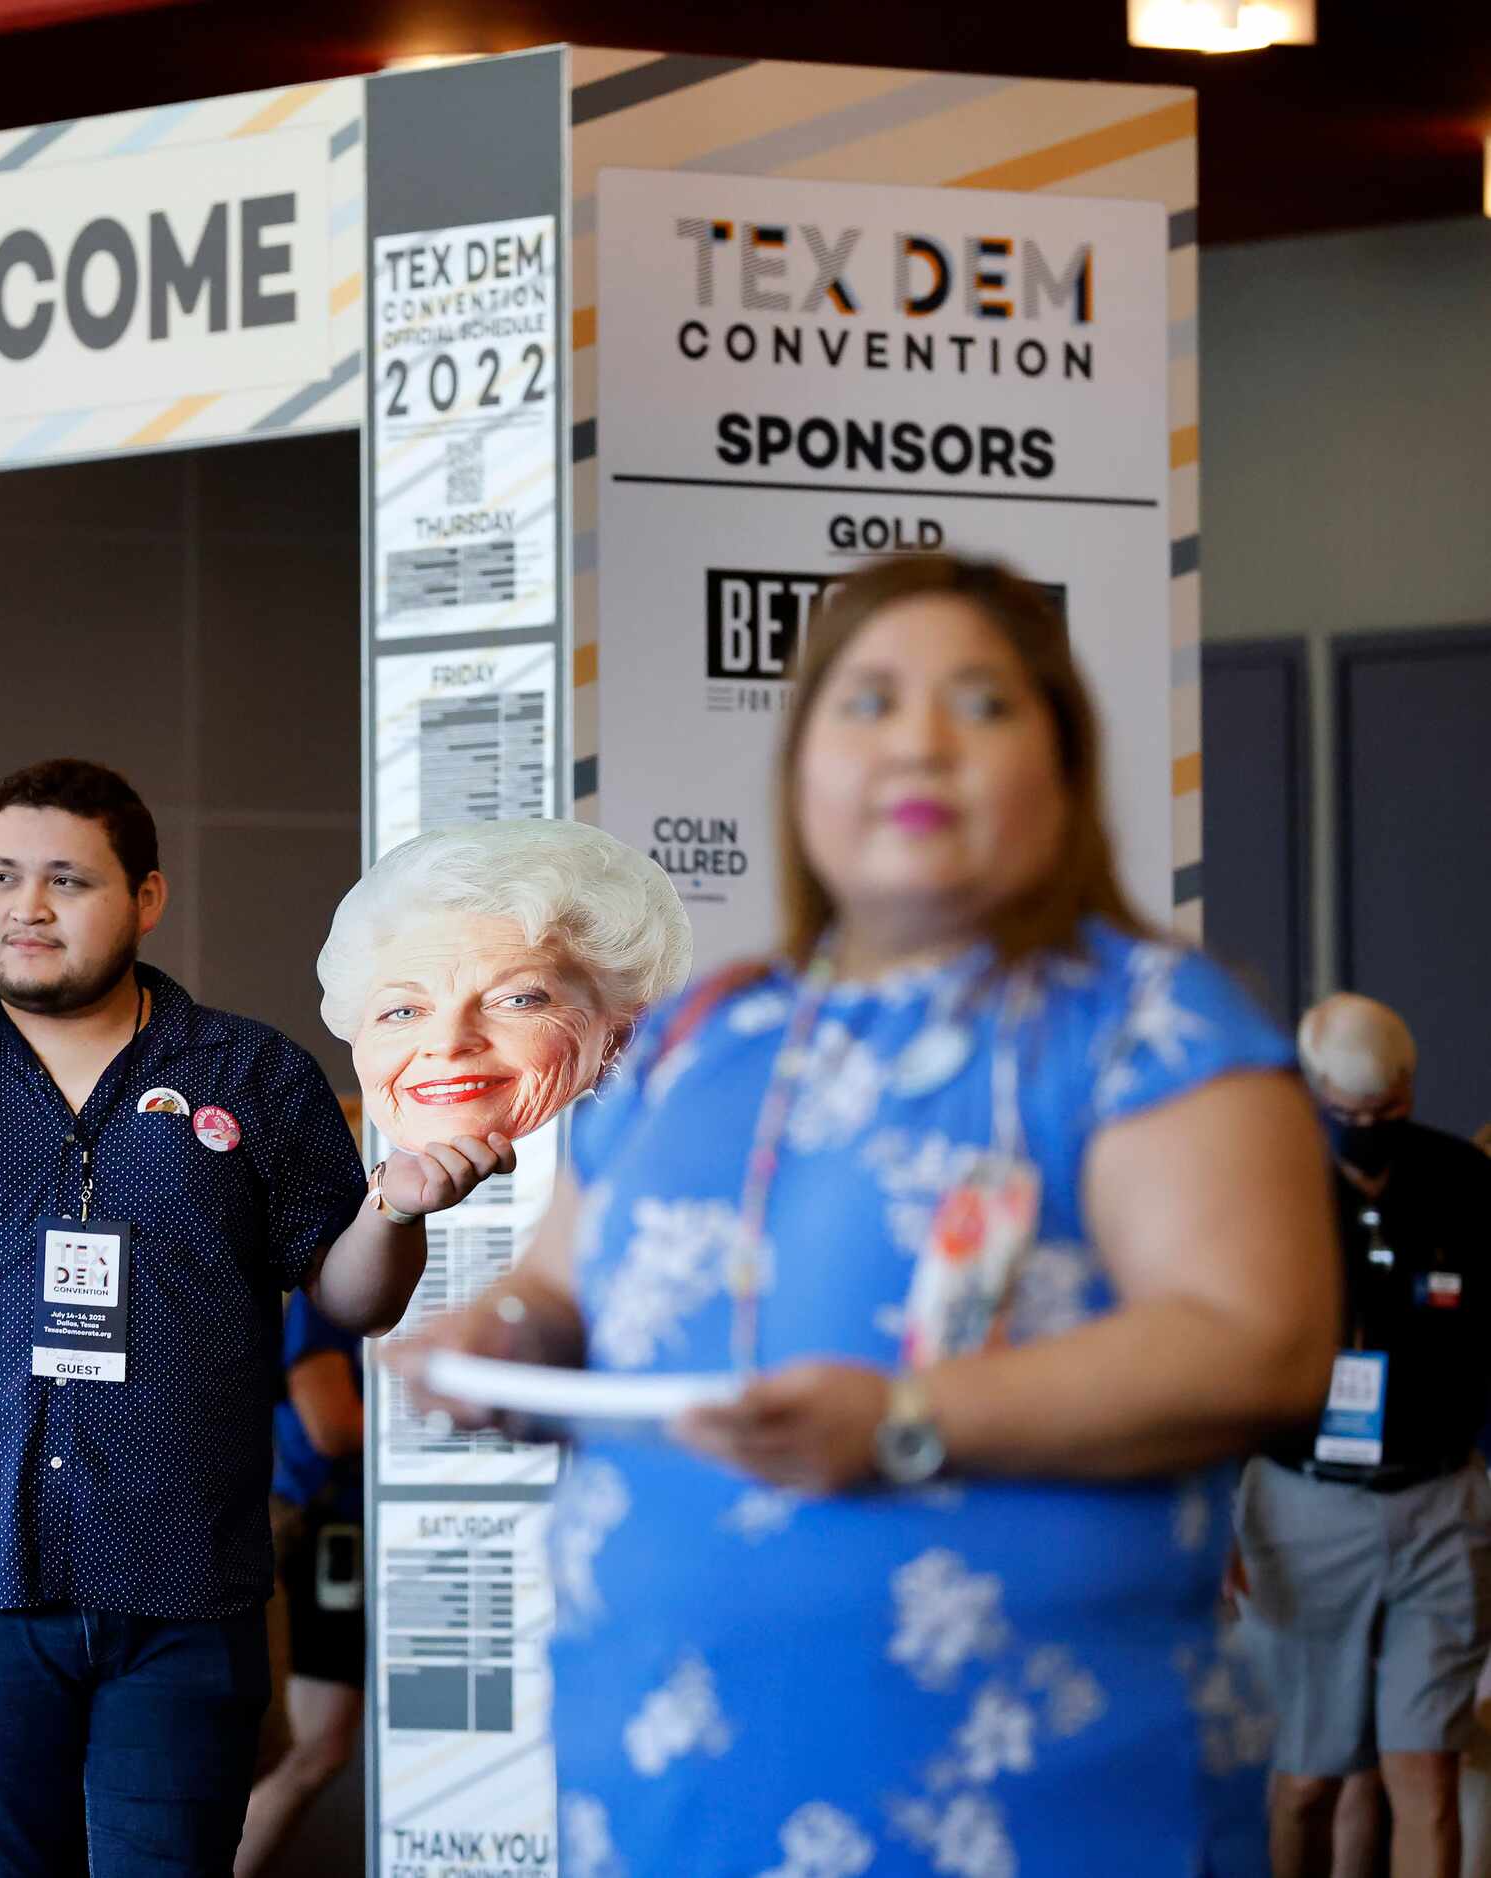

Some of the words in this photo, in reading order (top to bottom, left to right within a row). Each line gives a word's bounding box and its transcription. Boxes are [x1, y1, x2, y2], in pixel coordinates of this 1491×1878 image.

[385, 244, 453, 292] TEX
[466, 232, 545, 282] DEM
[676, 216, 861, 315] TEX
[895, 231, 1093, 325] DEM
[383, 285, 545, 325] CONVENTION
[678, 320, 1092, 380] CONVENTION
[386, 343, 546, 417] 2022
[716, 412, 1054, 479] SPONSORS
[416, 510, 515, 540] THURSDAY
[829, 514, 944, 551] GOLD
[431, 662, 498, 688] FRIDAY
[654, 816, 737, 843] COLIN
[54, 1241, 109, 1265] TEX
[53, 1286, 108, 1296] CONVENTION
[54, 1265, 109, 1287] DEM
[80, 1321, 99, 1329] Texas
[56, 1364, 101, 1375] GUEST
[417, 1513, 516, 1540] SATURDAY
[394, 1829, 485, 1863] THANK
[492, 1832, 549, 1865] YOU
